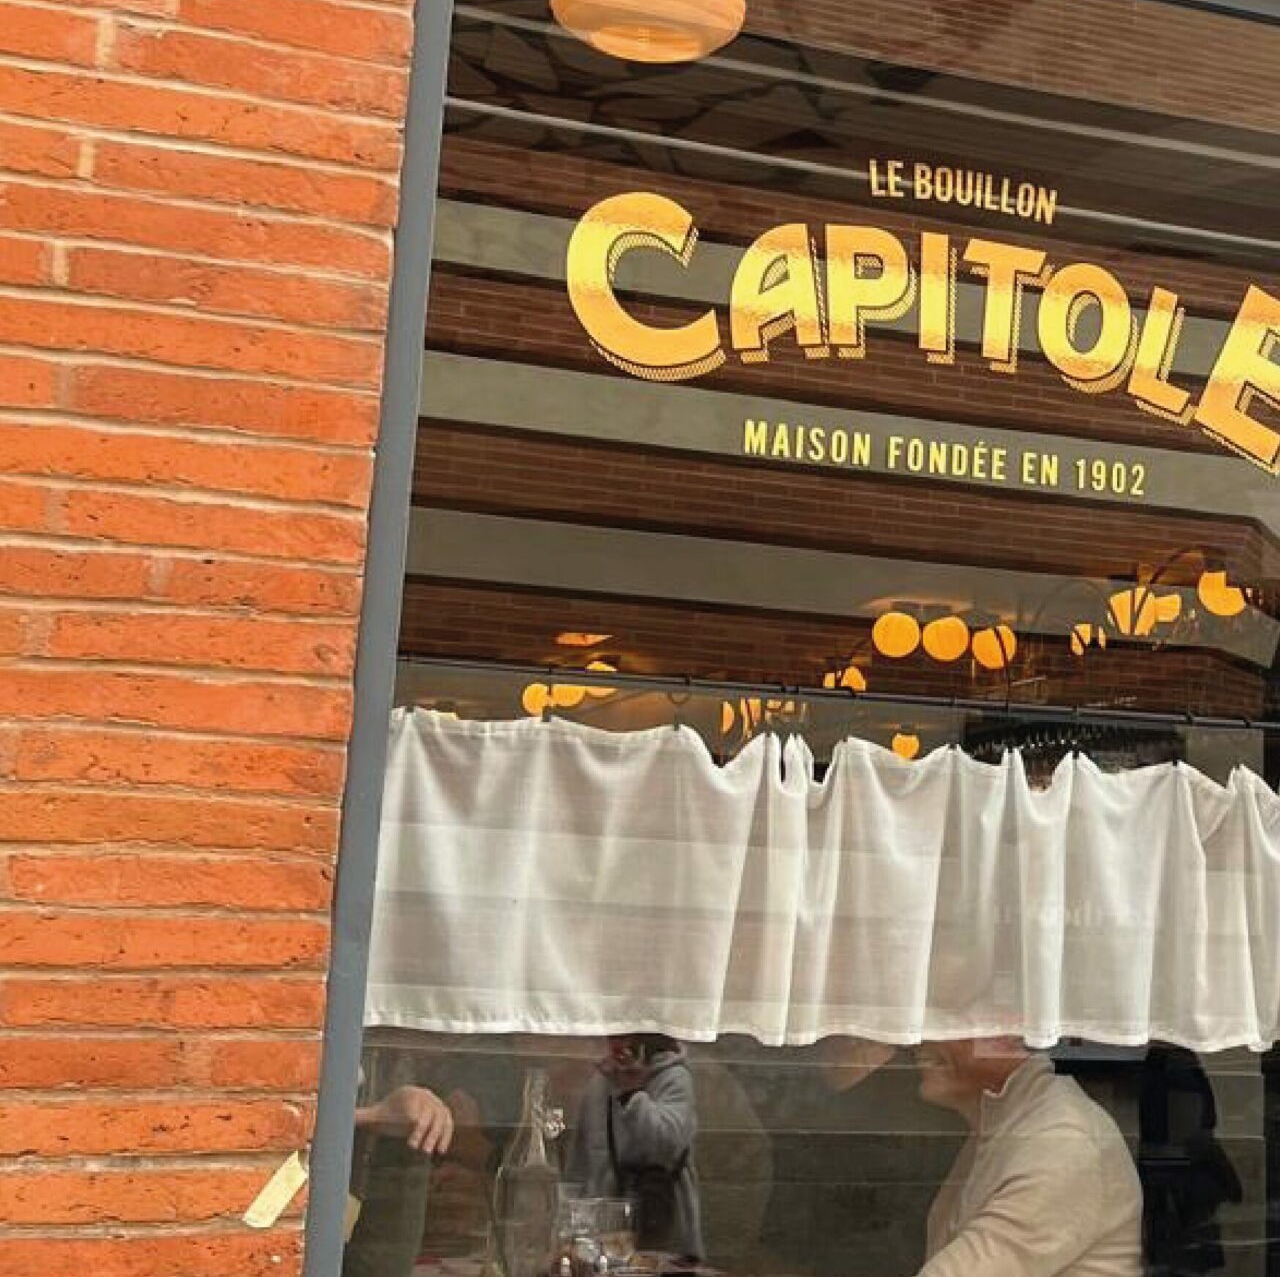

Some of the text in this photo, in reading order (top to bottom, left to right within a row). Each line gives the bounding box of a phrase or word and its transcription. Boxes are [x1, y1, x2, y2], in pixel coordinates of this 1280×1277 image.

[869, 157, 1058, 225] LE BOUILLON
[743, 418, 1146, 496] MAISON FONDÉE EN 1902
